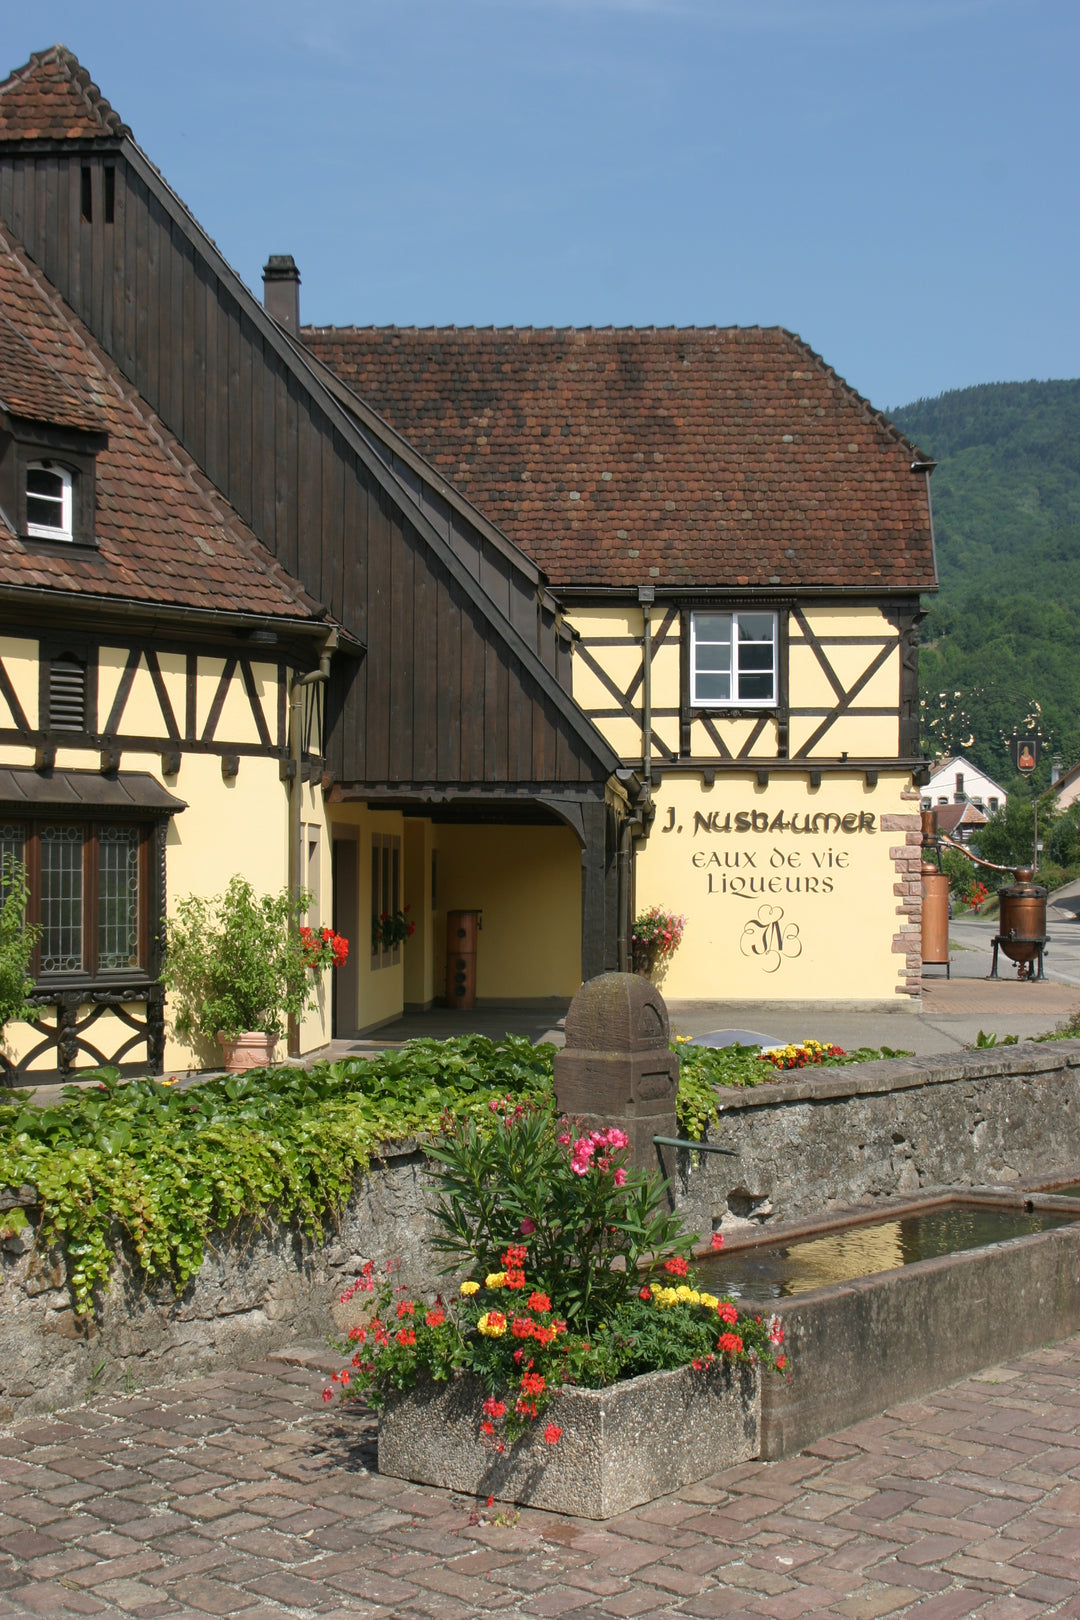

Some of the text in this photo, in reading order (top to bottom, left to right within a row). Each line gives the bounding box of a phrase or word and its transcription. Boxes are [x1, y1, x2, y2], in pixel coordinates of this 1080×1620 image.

[662, 806, 878, 835] J. NUSBAUMER
[691, 851, 757, 869] EAUX
[769, 848, 802, 868] DE
[707, 873, 835, 899] LIQUEURS
